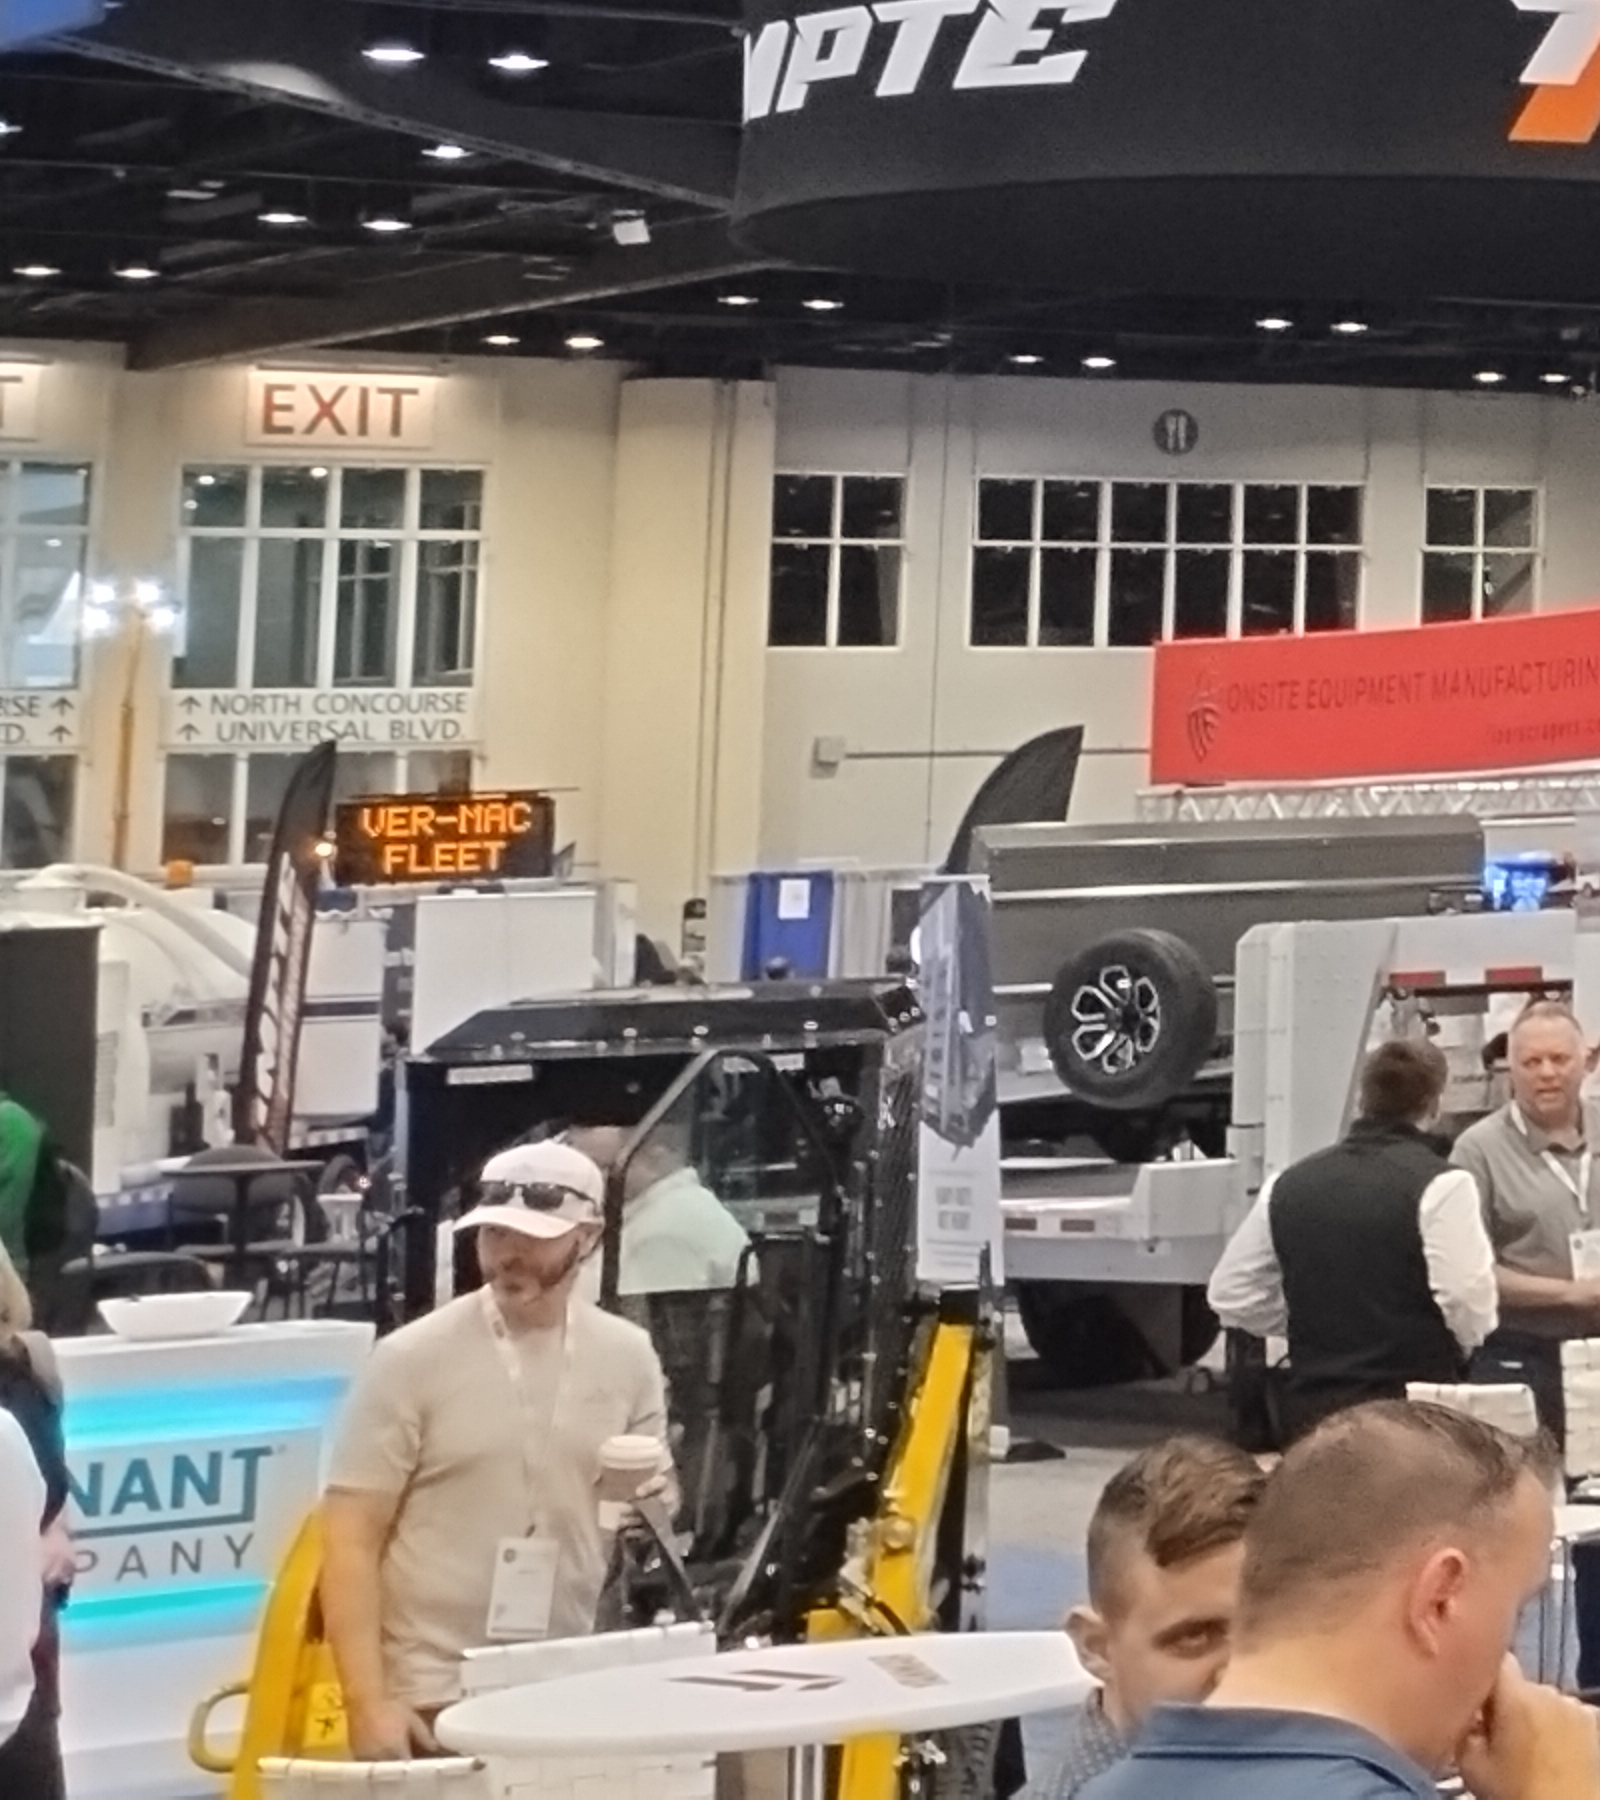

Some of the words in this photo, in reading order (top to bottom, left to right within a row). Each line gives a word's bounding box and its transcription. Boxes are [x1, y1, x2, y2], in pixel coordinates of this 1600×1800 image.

[261, 383, 420, 437] EXIT
[210, 694, 301, 716] NORTH
[313, 692, 467, 715] CONCOURSE
[1227, 682, 1300, 714] ONSITE
[1304, 672, 1426, 711] EQUIPMENT
[216, 719, 377, 742] UNIVERSAL
[389, 719, 466, 741] BLVD.
[364, 802, 532, 838] VER-MAC
[383, 841, 505, 876] FLEET
[66, 1446, 273, 1524] NANT
[74, 1534, 255, 1581] PANY
